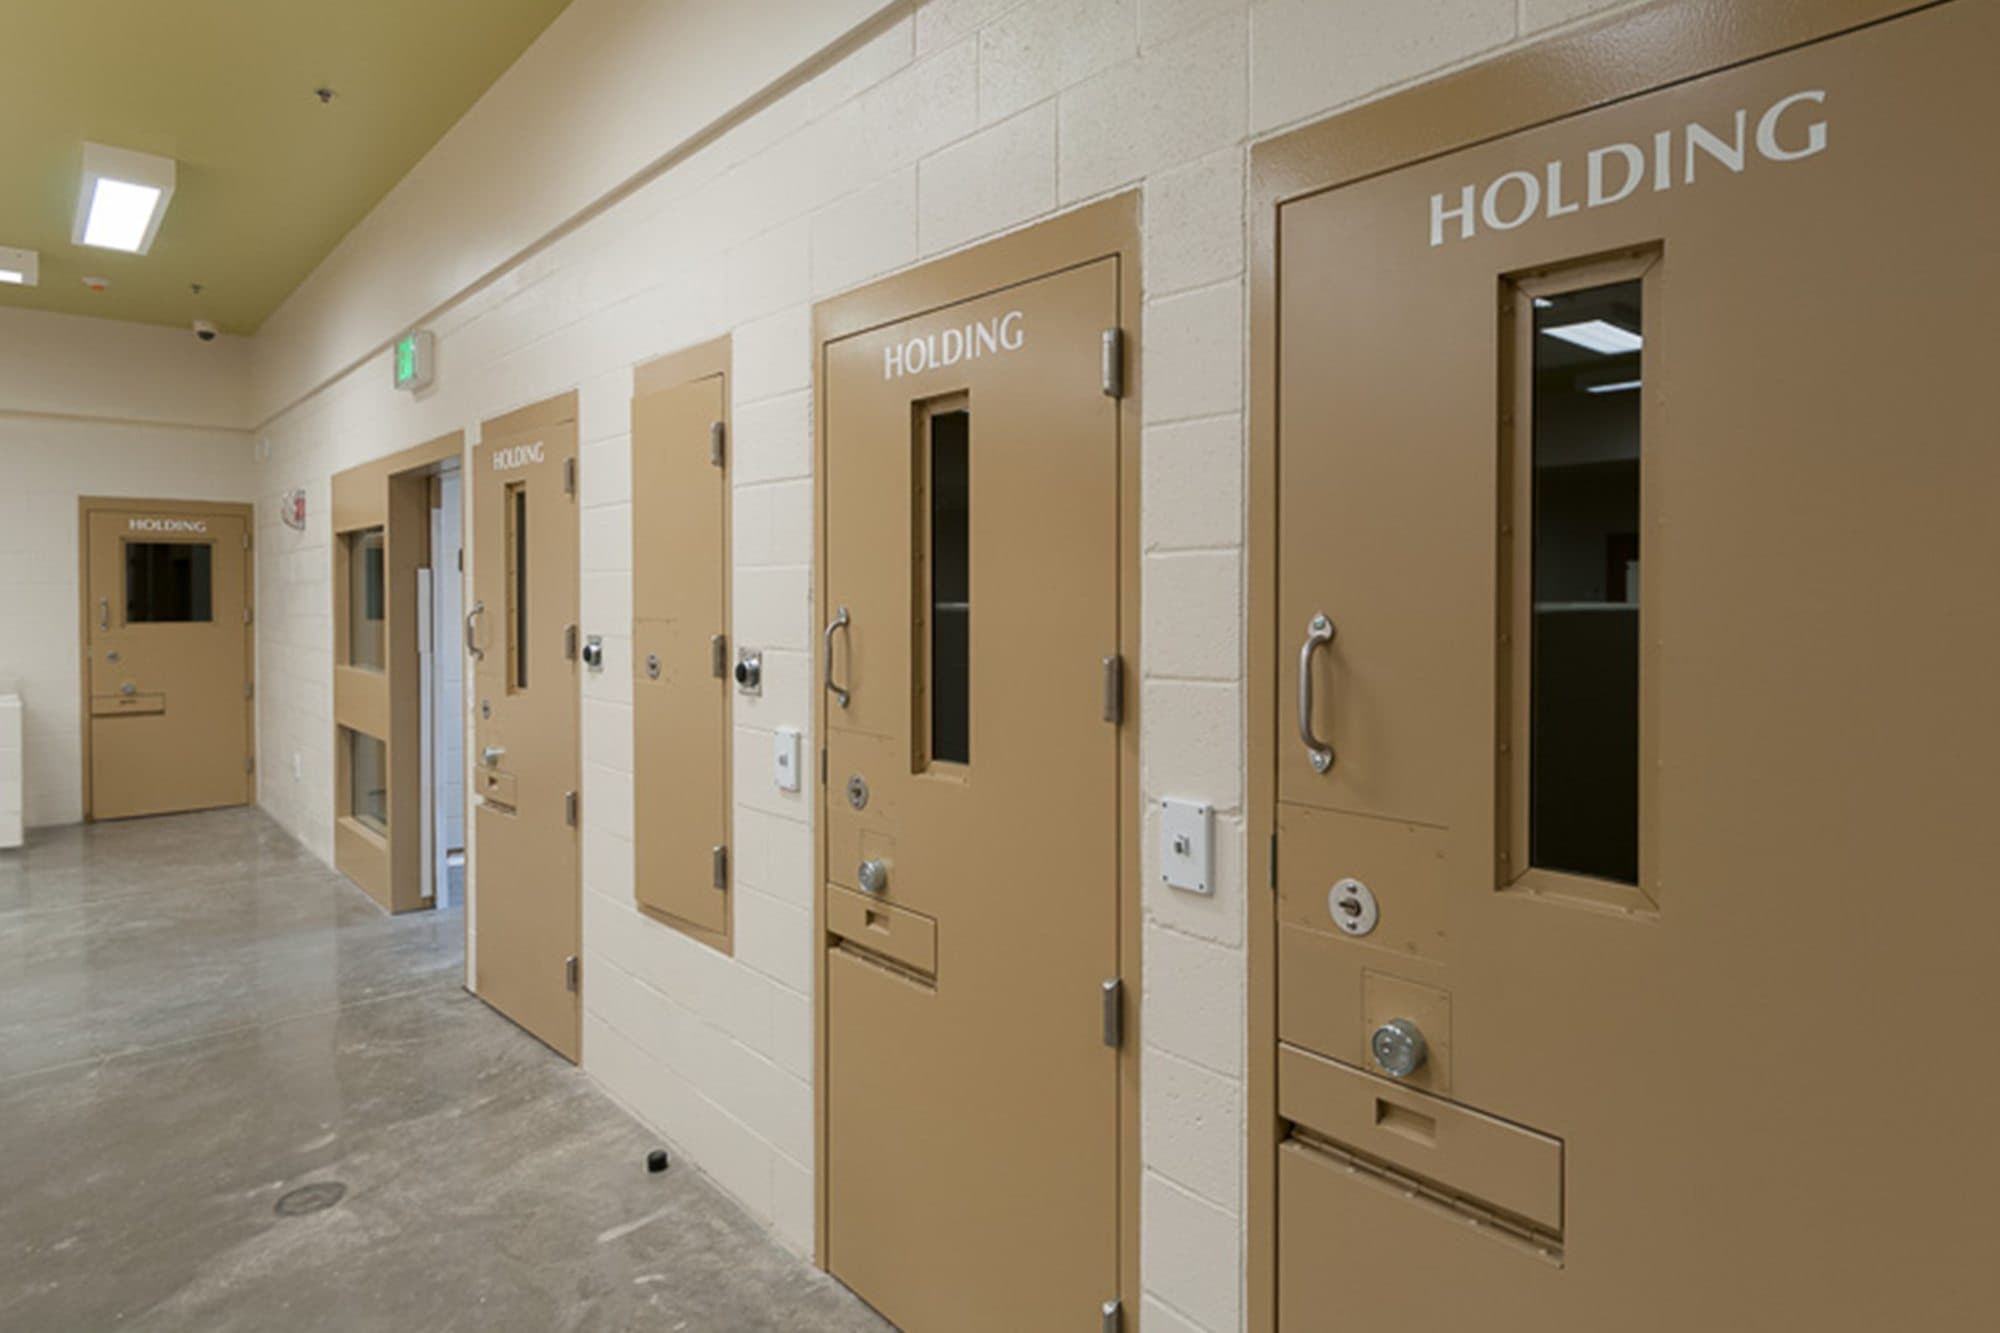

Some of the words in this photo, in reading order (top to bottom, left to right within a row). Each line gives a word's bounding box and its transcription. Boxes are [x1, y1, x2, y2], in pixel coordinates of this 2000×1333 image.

[1429, 90, 1828, 247] HOLDING
[884, 310, 1024, 380] HOLDING
[493, 441, 544, 471] HOLDING
[128, 519, 207, 533] HOLDING
